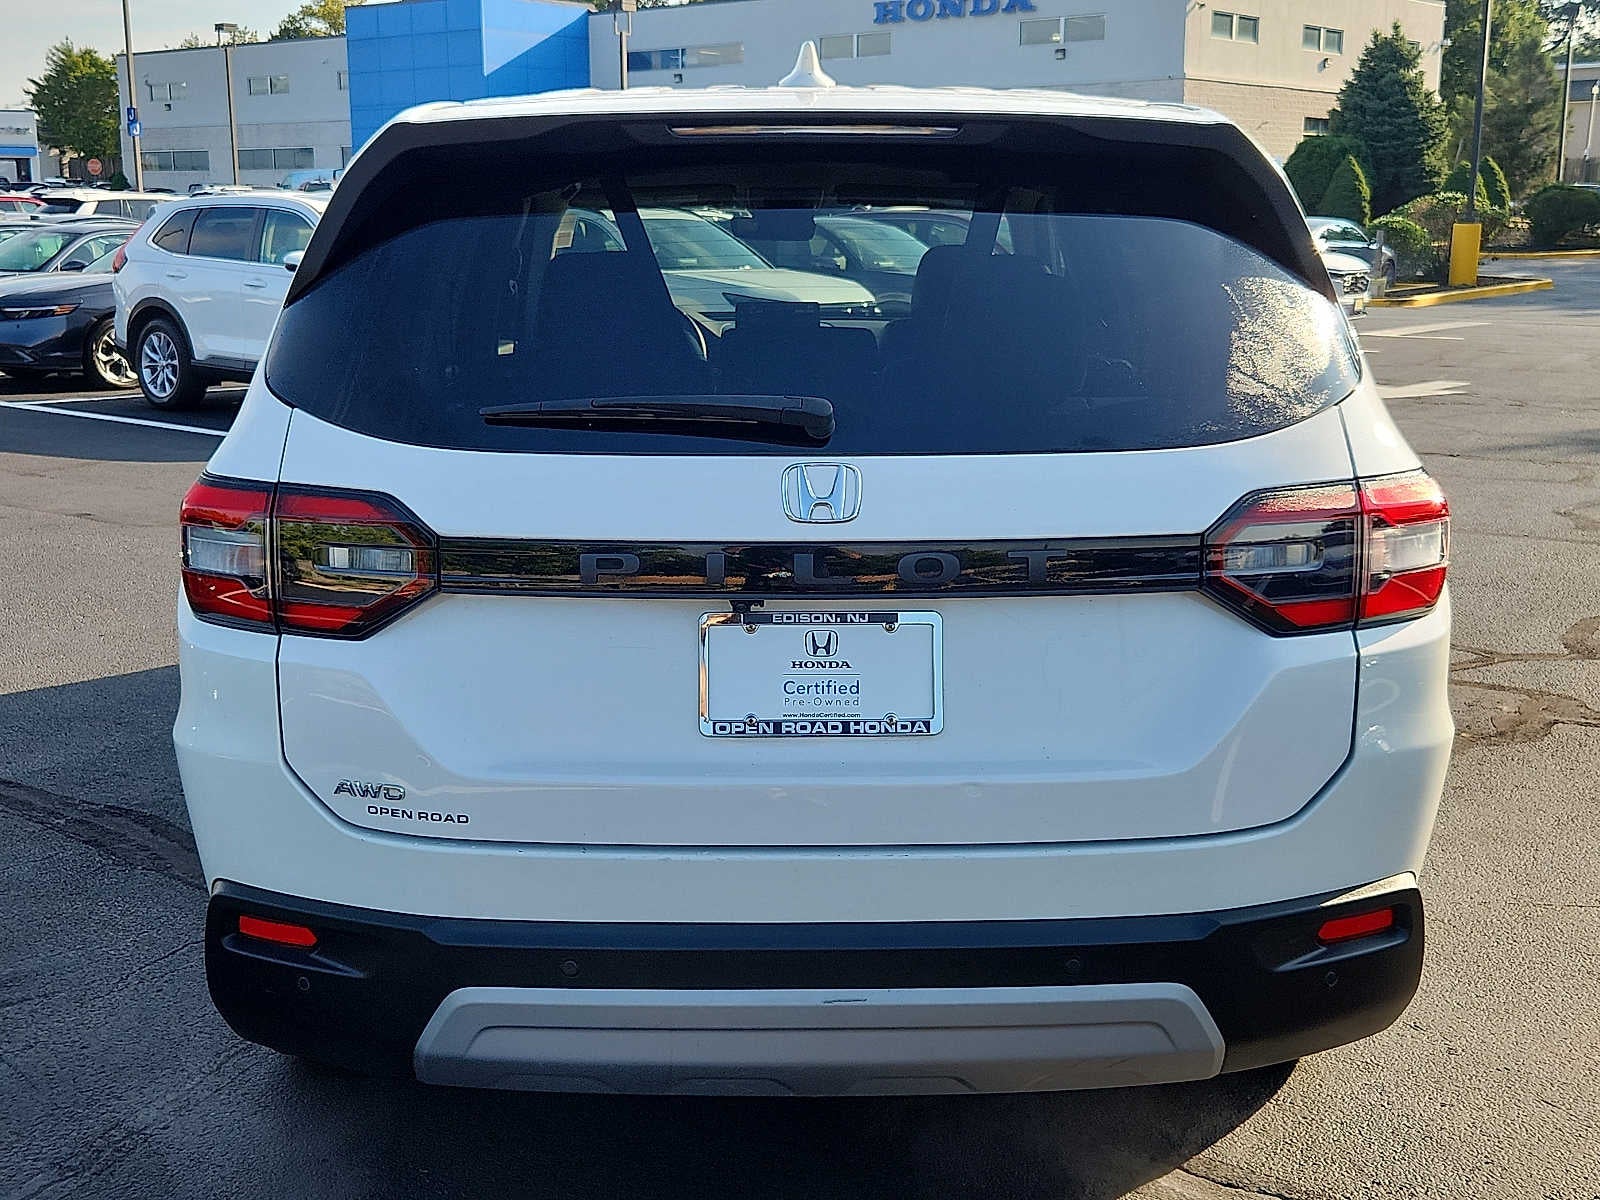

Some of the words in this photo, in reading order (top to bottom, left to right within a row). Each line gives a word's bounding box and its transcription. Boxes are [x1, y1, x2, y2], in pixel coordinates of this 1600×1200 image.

[873, 0, 1036, 24] HONDA
[579, 549, 1067, 586] PILOT
[772, 613, 841, 623] EDISON,
[850, 613, 869, 623] NJ
[791, 660, 852, 669] HONDA
[783, 679, 860, 695] Certified
[784, 697, 859, 706] Pre-Owned
[714, 722, 774, 734] OPEN
[781, 721, 843, 734] ROAD
[850, 721, 928, 734] HONDA
[334, 779, 406, 801] AWD
[367, 805, 413, 819] OPEN
[418, 811, 469, 824] ROAD
